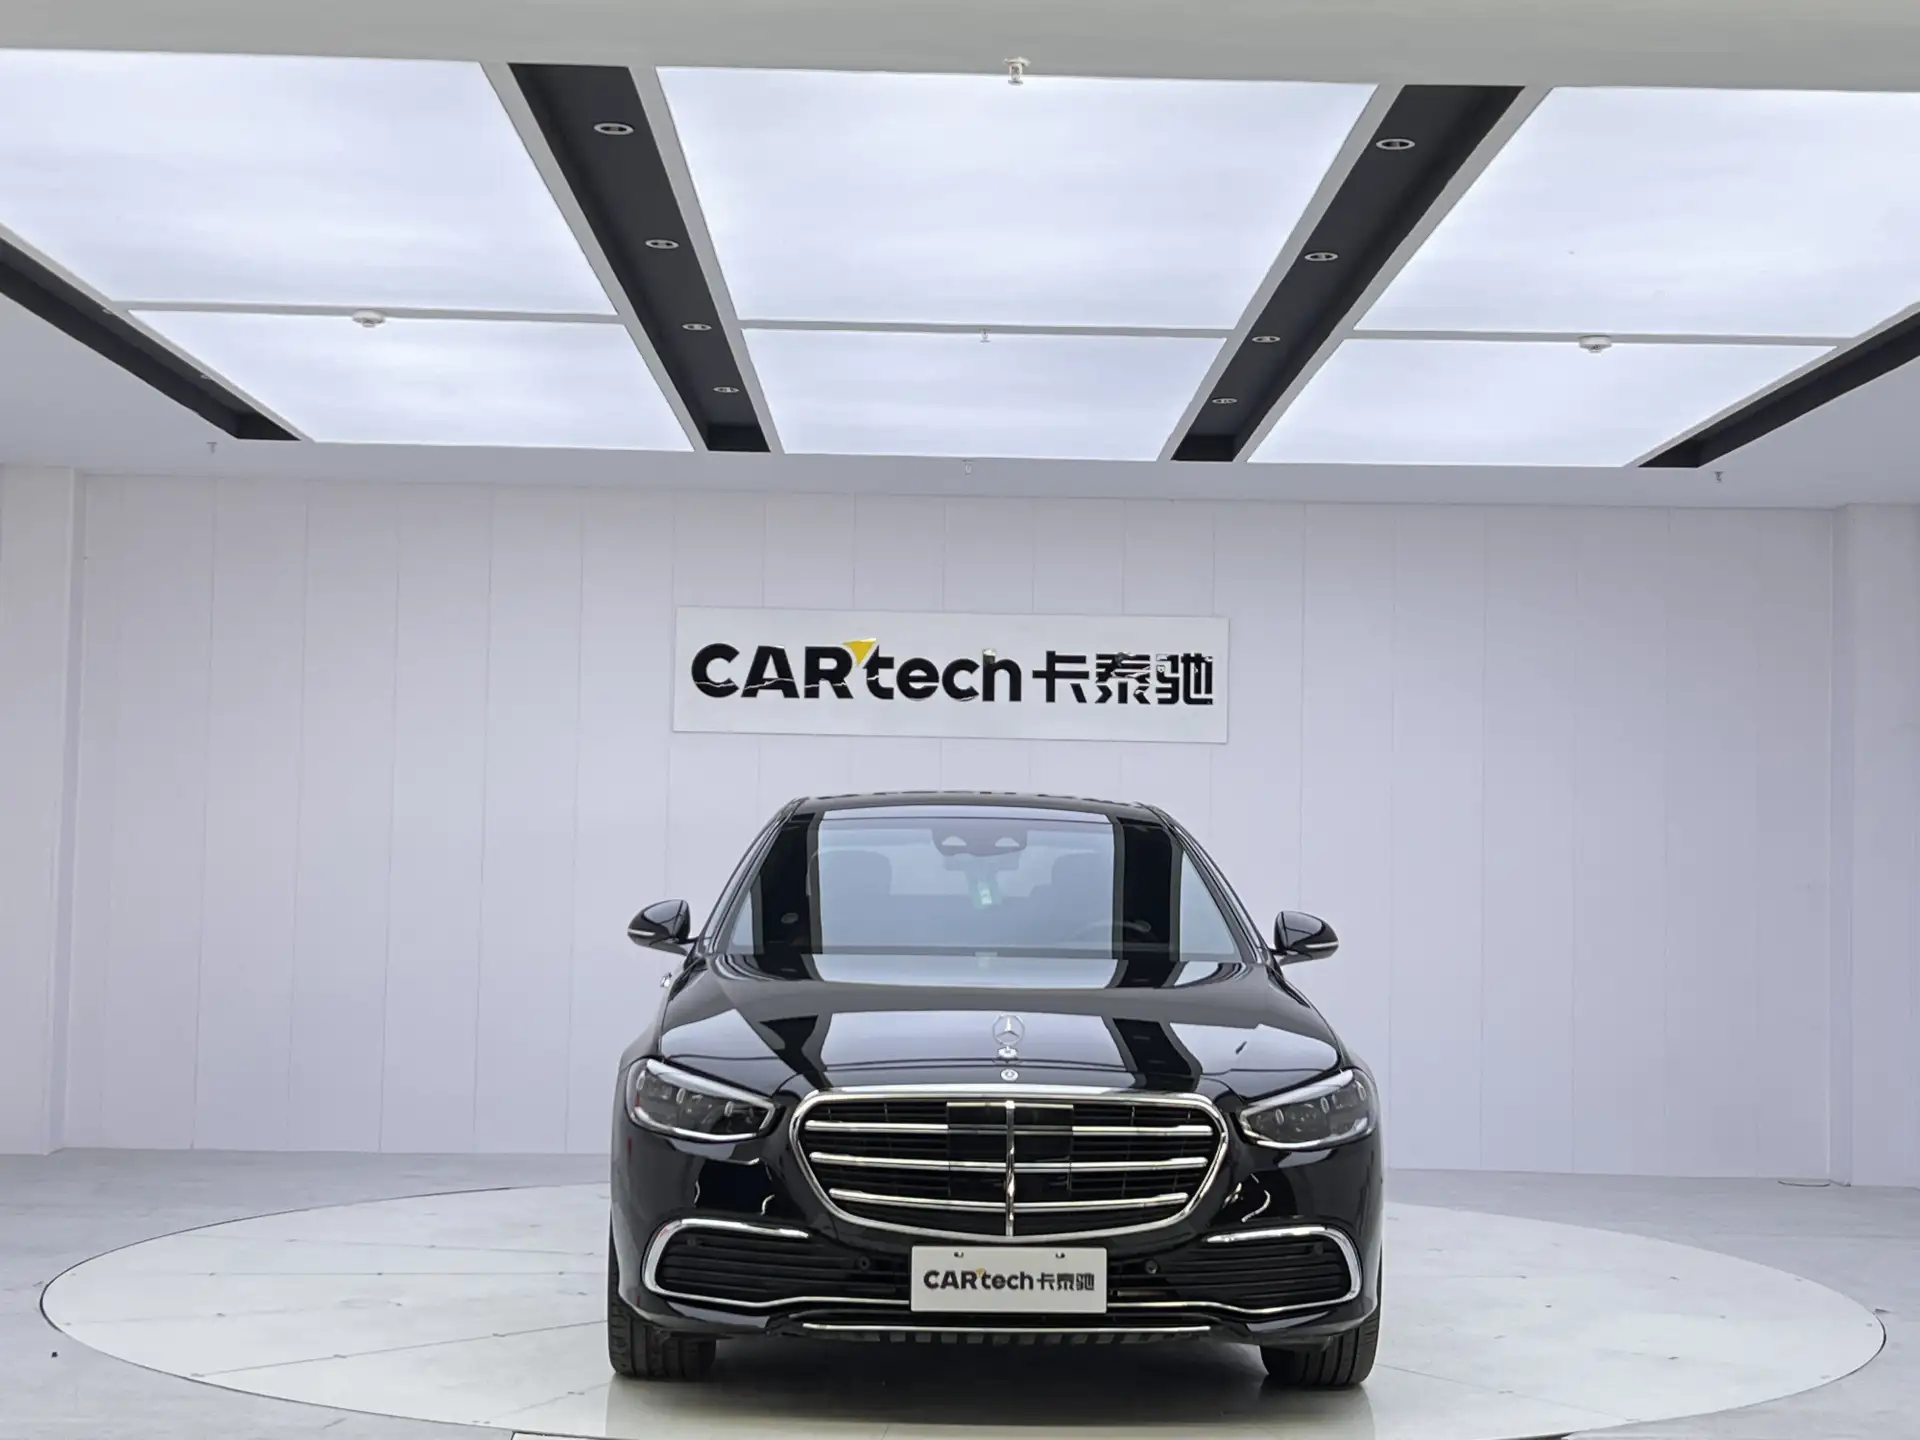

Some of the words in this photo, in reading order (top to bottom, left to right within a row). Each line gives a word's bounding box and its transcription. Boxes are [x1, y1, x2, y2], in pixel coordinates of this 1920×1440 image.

[690, 638, 1023, 702] CARtech
[1031, 651, 1214, 706] 卡泰驰
[923, 1268, 1034, 1291] CARtech
